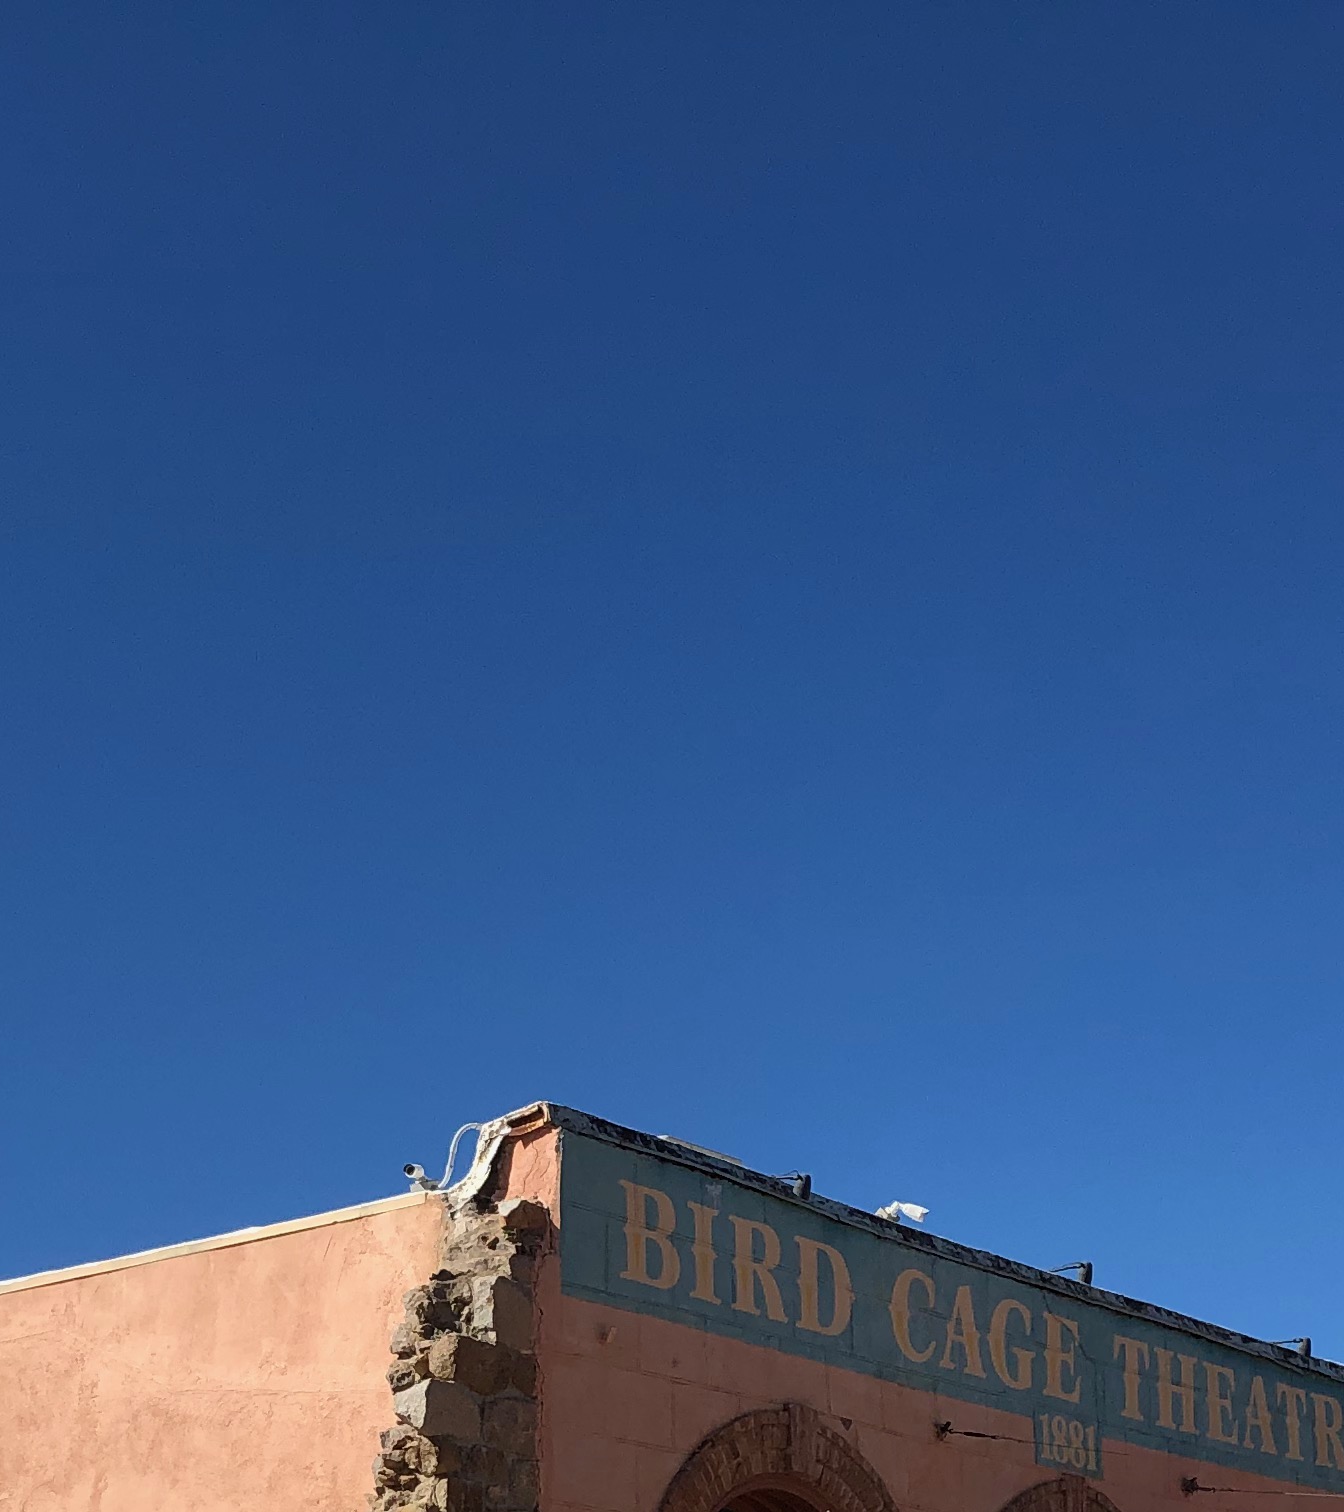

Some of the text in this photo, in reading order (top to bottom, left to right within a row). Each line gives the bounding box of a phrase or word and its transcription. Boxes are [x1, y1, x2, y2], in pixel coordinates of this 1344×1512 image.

[619, 1180, 856, 1336] BIRD
[889, 1269, 1081, 1404] CAGE
[1039, 1413, 1097, 1471] 1881
